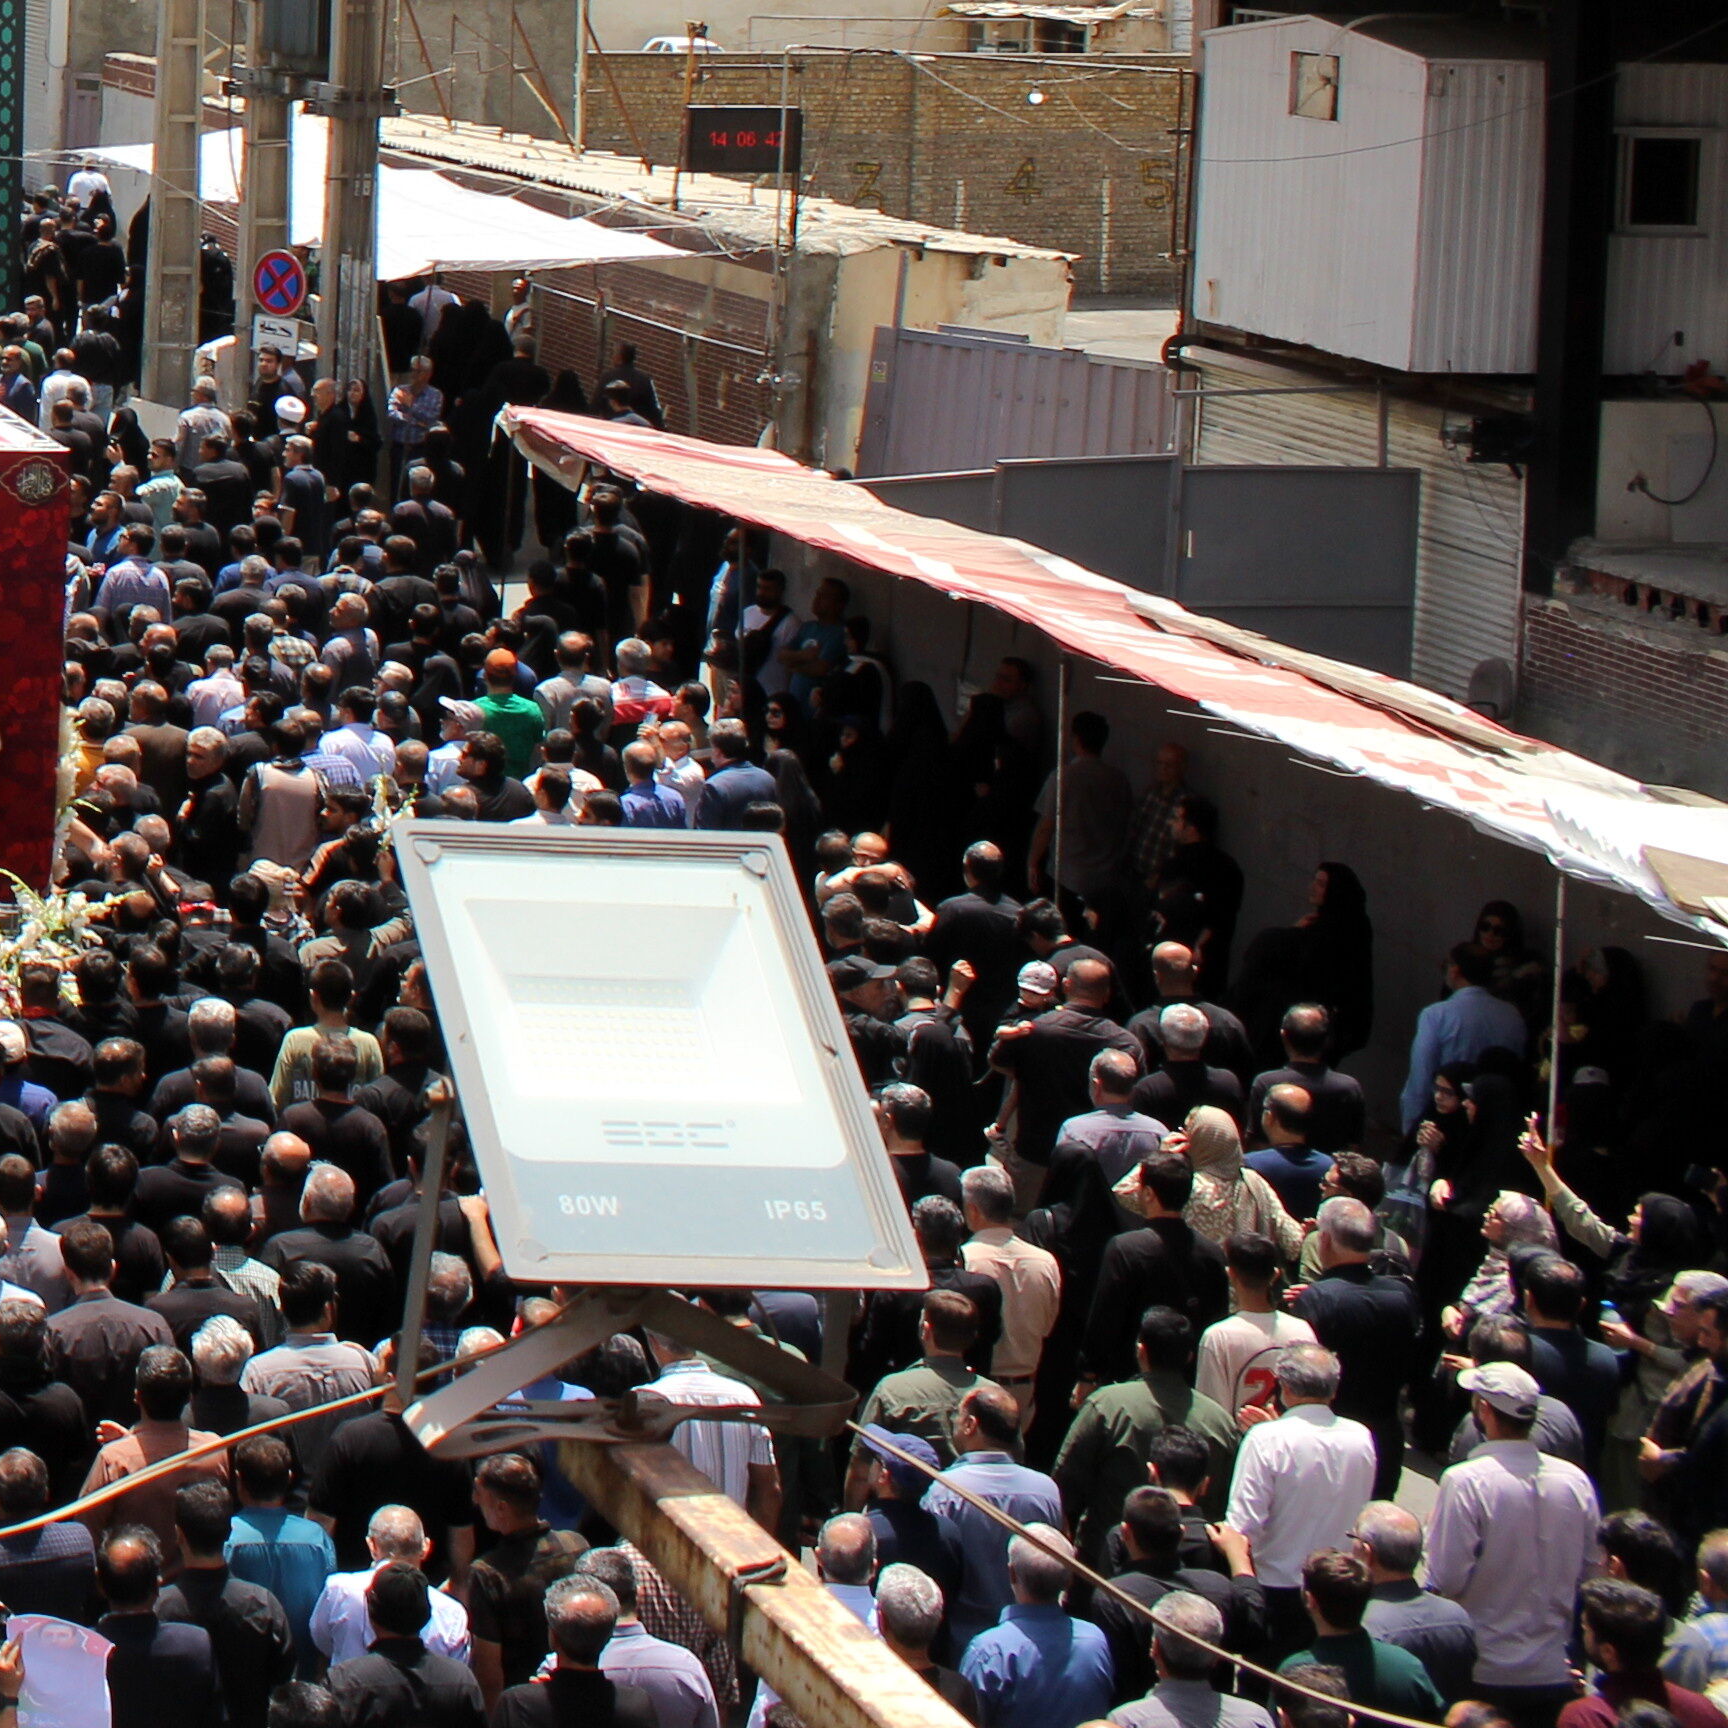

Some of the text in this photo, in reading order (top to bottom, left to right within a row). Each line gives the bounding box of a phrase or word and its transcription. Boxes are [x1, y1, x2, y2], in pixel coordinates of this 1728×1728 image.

[708, 131, 728, 147] 14
[737, 131, 756, 147] 06
[1004, 157, 1042, 206] 4
[1142, 158, 1174, 209] 5
[557, 1194, 828, 1221] 80W IP65
